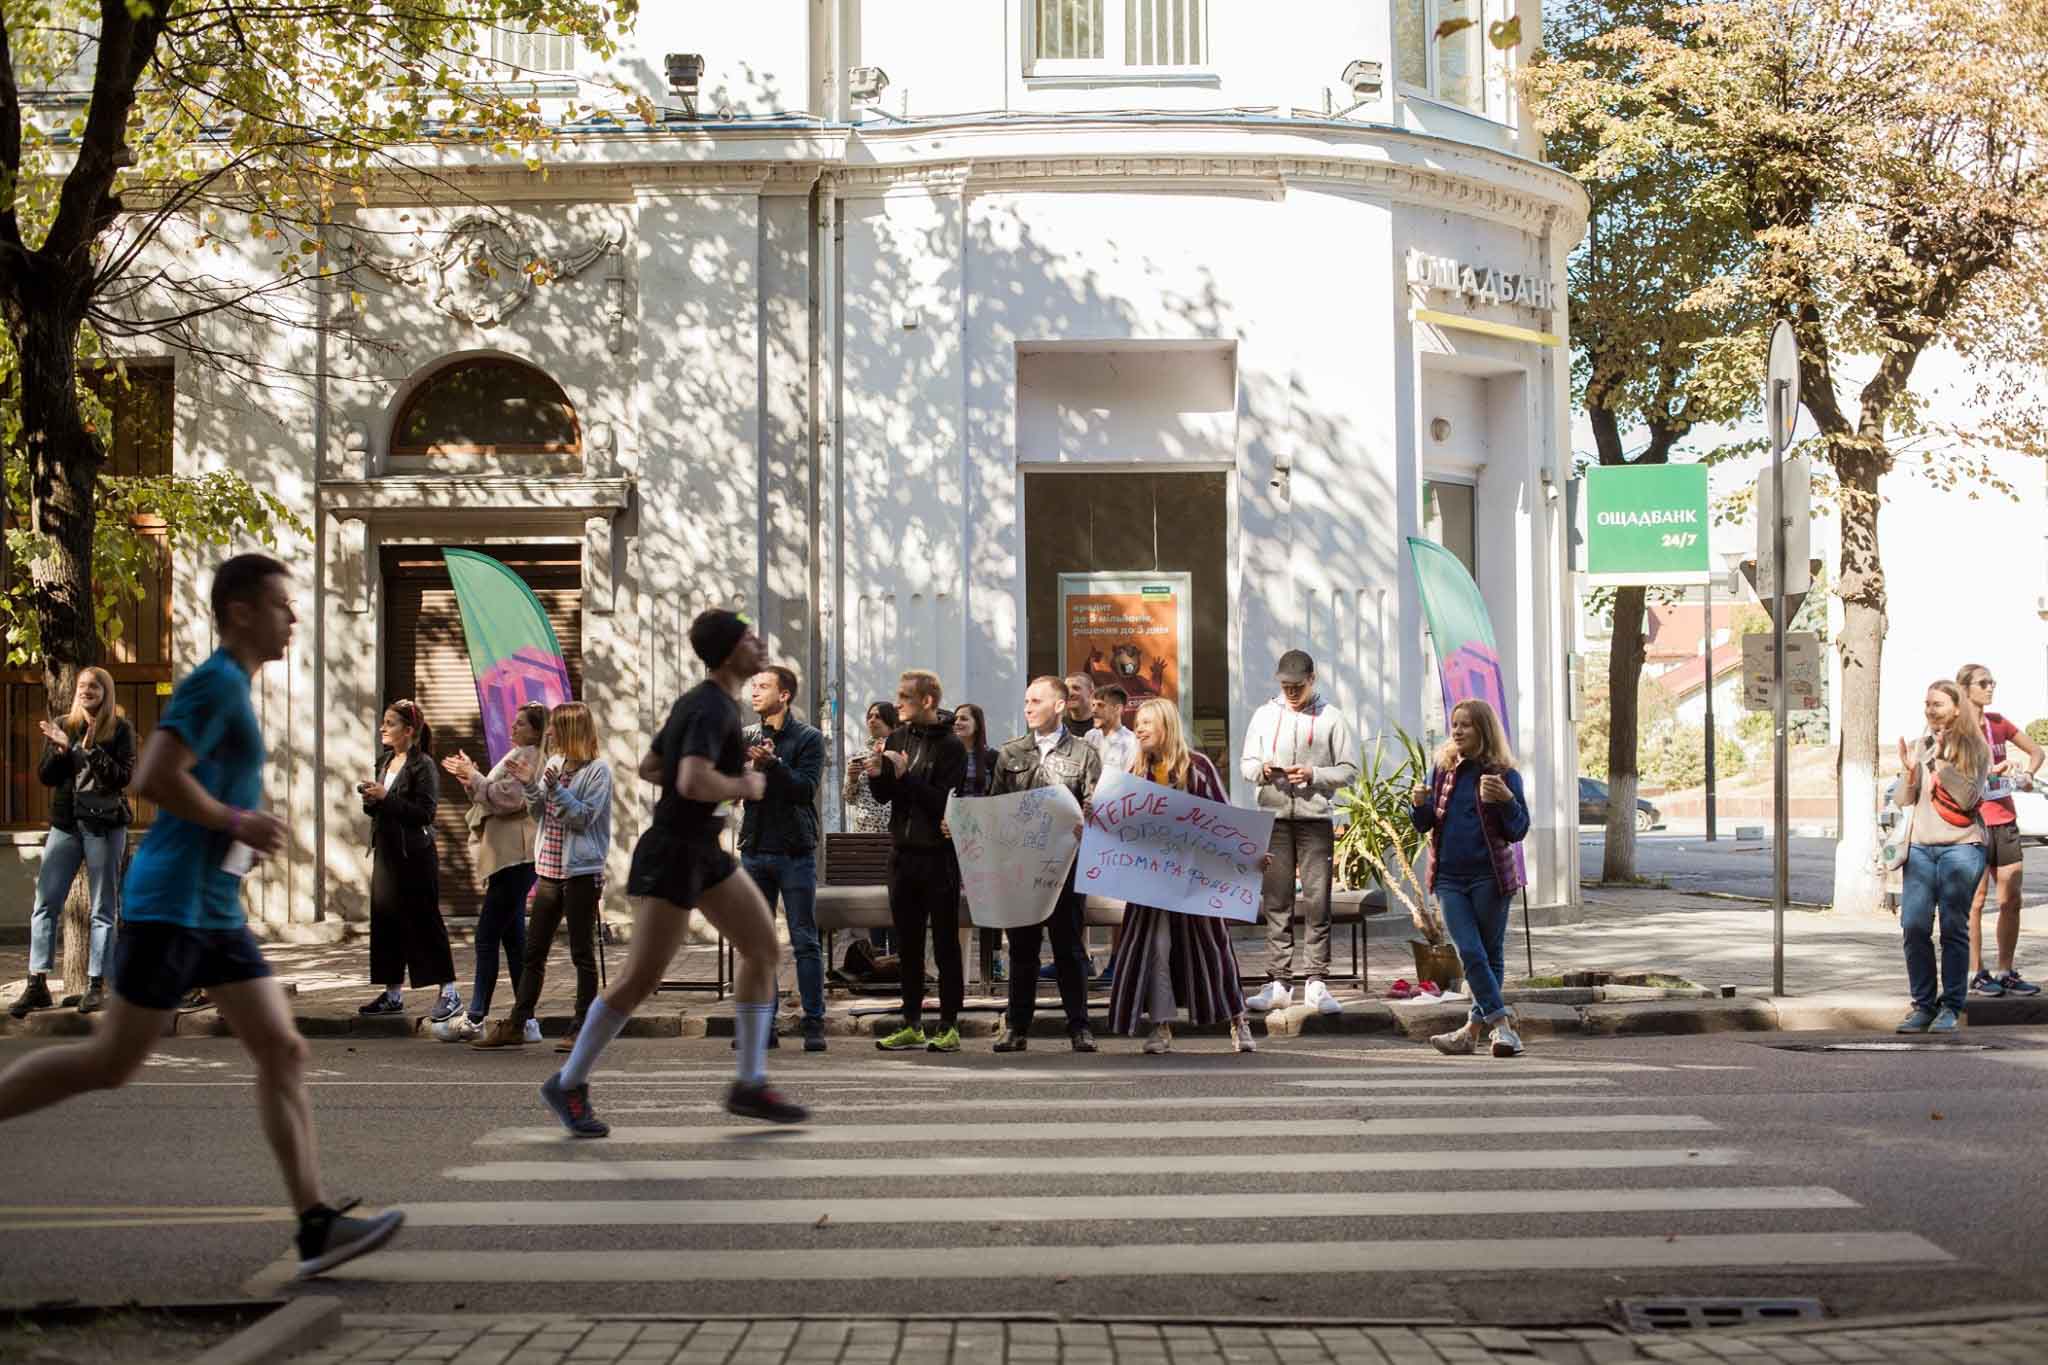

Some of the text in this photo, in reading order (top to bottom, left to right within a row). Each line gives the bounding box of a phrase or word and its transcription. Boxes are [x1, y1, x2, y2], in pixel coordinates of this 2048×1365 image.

[1415, 252, 1560, 312] ОЩАДБАНК
[1597, 509, 1697, 527] ОЩАДБАНК
[1661, 533, 1697, 549] 24/7
